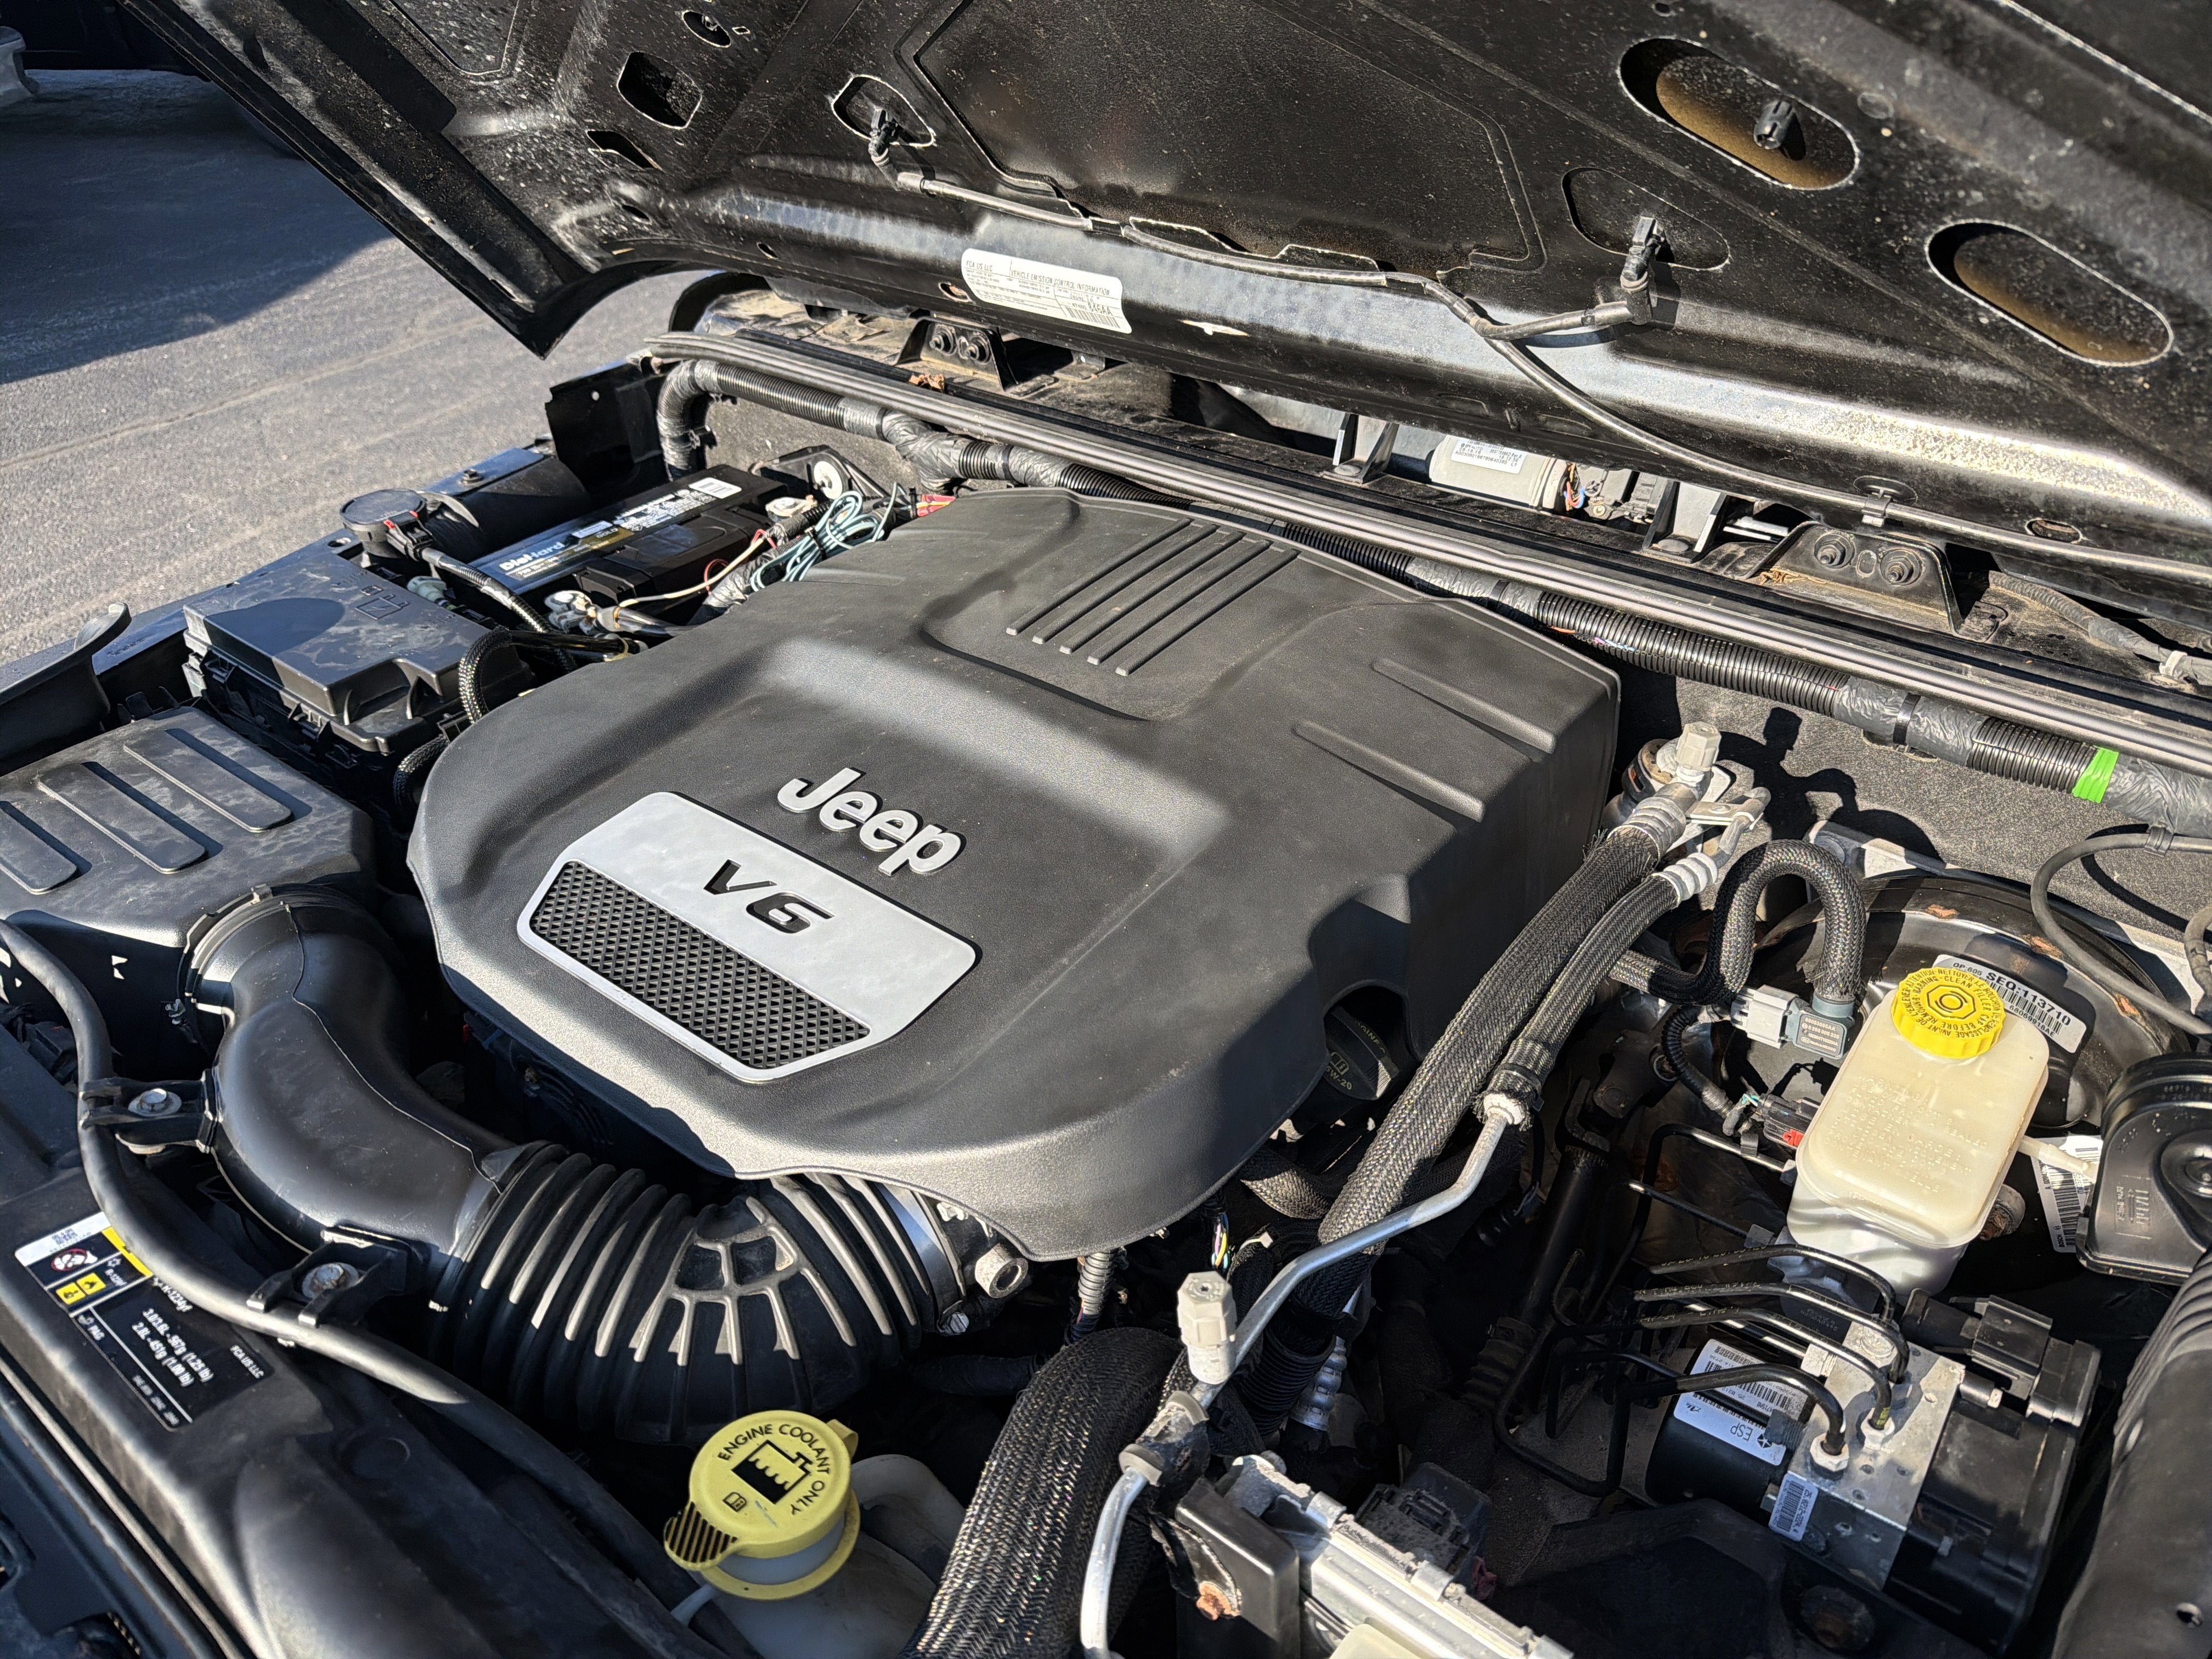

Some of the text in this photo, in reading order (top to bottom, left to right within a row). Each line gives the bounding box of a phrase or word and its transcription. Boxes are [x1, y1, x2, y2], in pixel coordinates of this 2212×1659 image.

[1010, 269, 1030, 279] VEHICLE
[1030, 274, 1053, 284] EMISSION
[1053, 278, 1076, 289] CONTROL
[1076, 283, 1110, 296] INFORMATION
[499, 541, 566, 571] DieHard
[777, 767, 964, 876] Jeep
[703, 858, 836, 934] V6
[1944, 976, 1973, 989] CLEAN
[1973, 989, 1991, 1011] FILLER
[1986, 972, 2071, 1026] SEQ:113710
[1941, 1022, 1977, 1031] BEFORE
[1976, 1014, 1989, 1025] CAP
[2009, 1005, 2055, 1037] 68069918AE
[87, 1324, 105, 1341] PAG
[229, 1344, 246, 1361] FCA
[1730, 1424, 1753, 1442] ESP
[717, 1423, 830, 1516] ENGINE COOLANT ONLY
